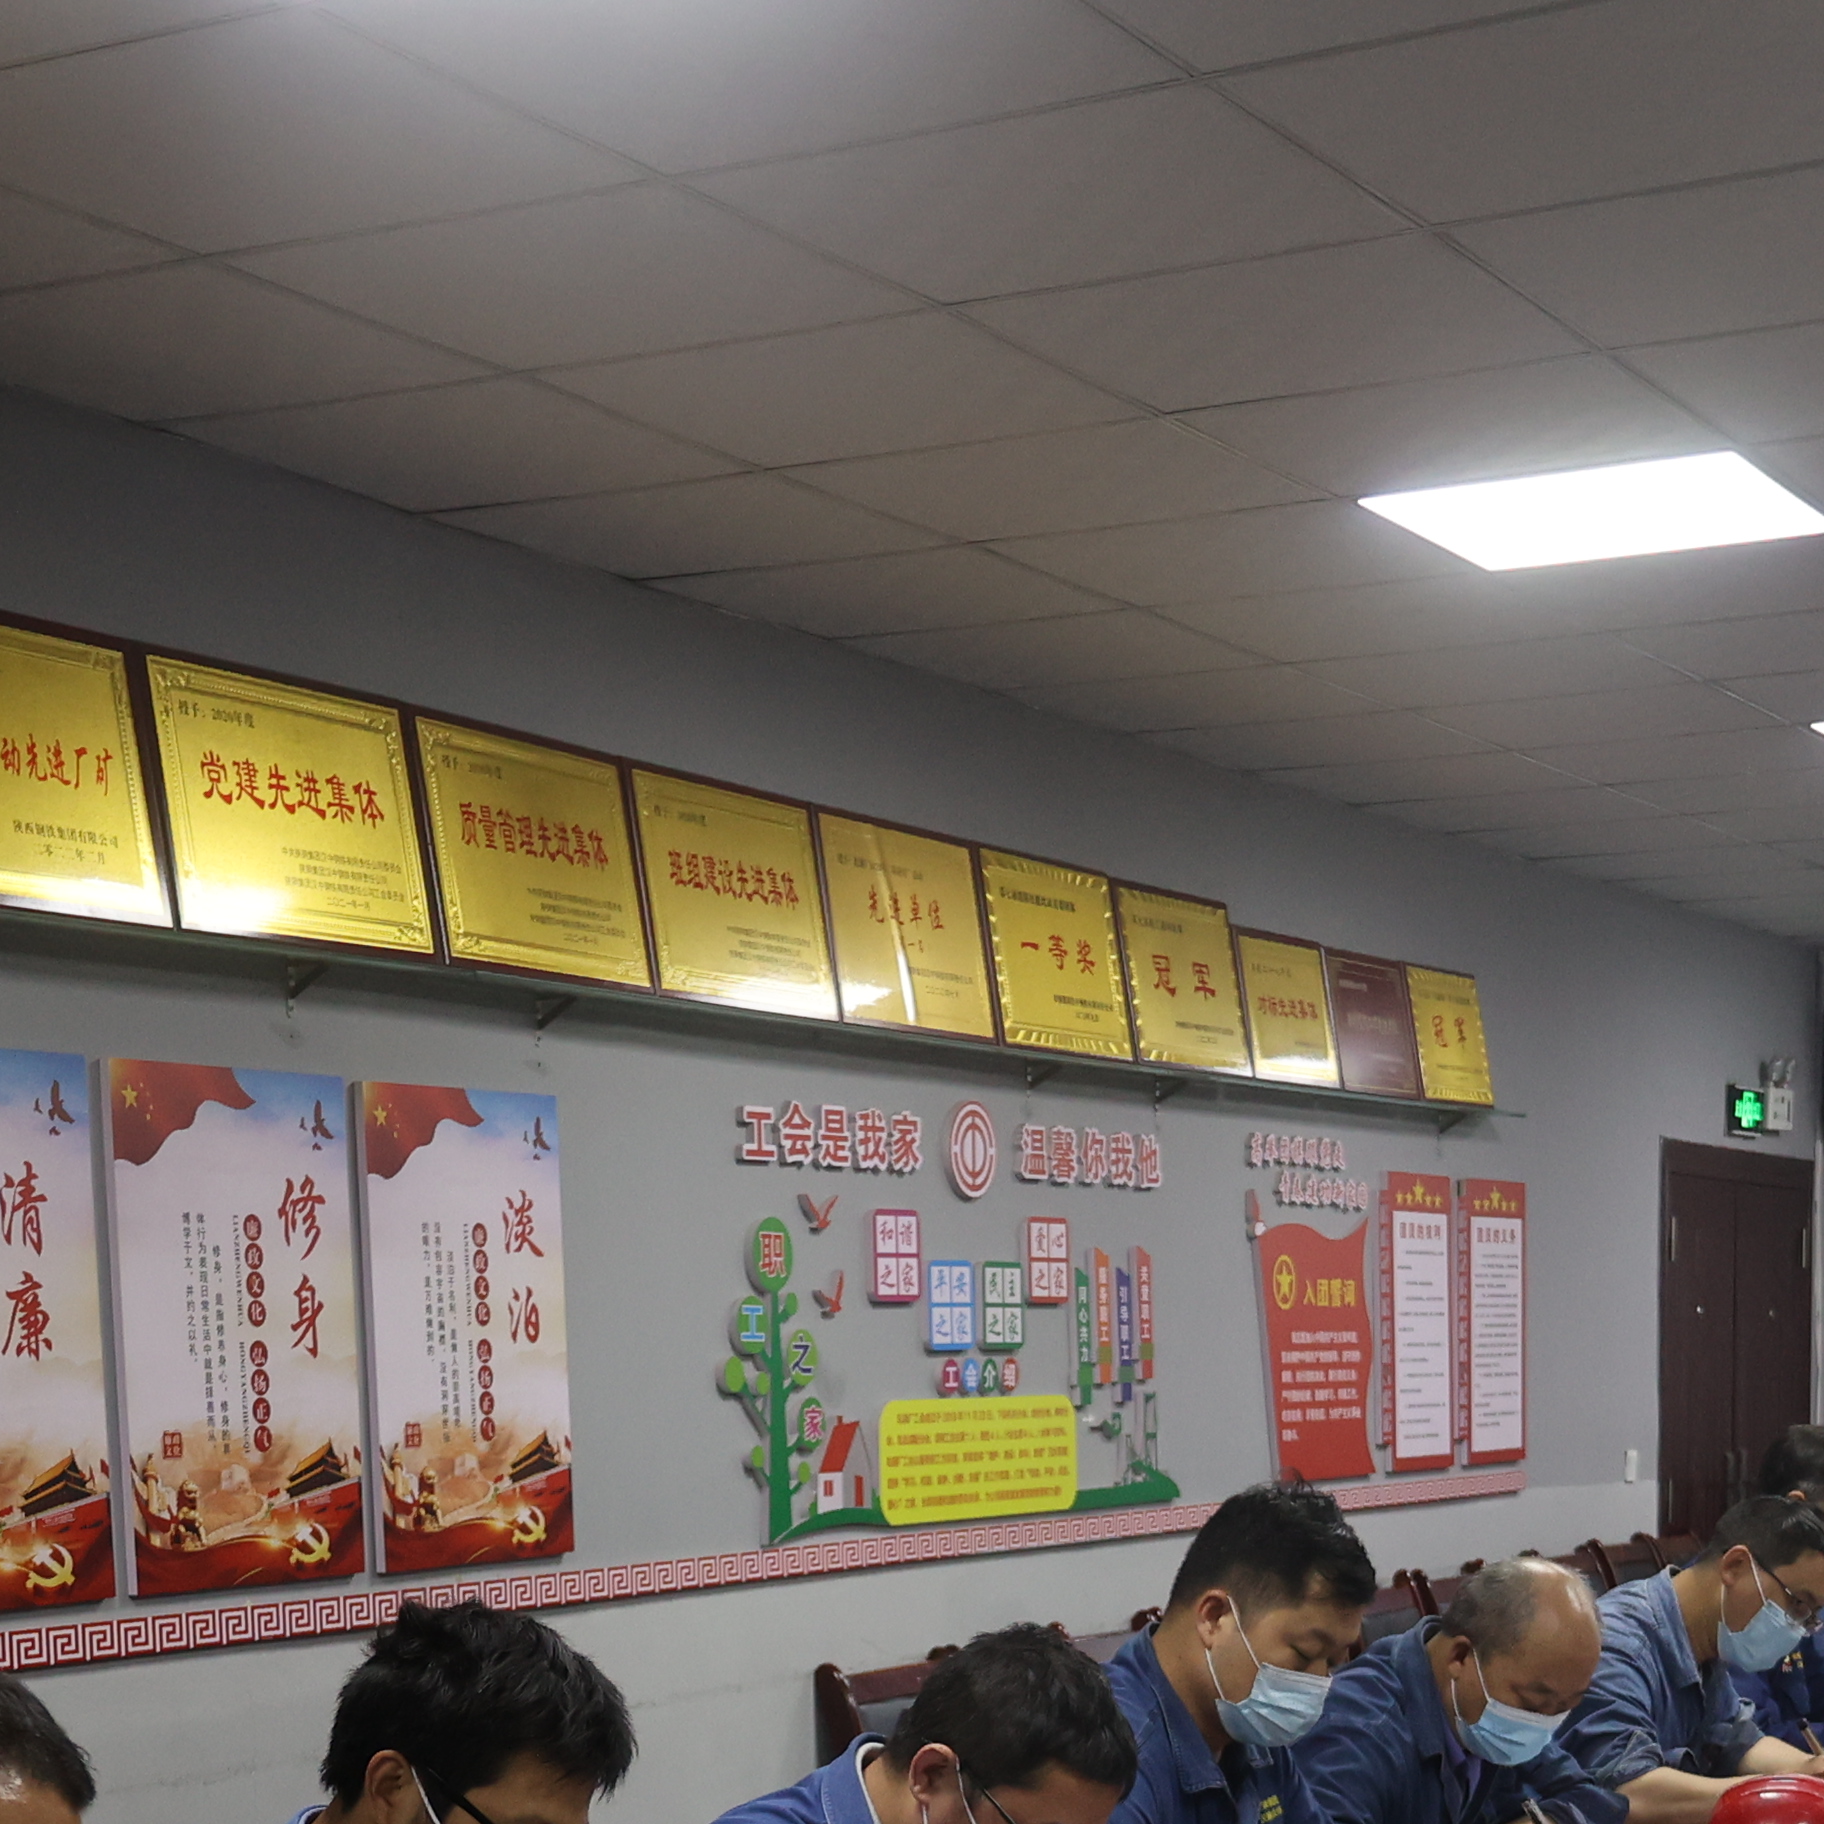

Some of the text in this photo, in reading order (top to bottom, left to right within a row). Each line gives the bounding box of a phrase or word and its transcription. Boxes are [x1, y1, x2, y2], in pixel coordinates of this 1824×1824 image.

[200, 750, 384, 829] 党建先进集体
[459, 801, 609, 872] 质量管理先进集体
[668, 850, 799, 910] 班组建设先进集体
[742, 1103, 921, 1169] 工会是我家
[1022, 1125, 1161, 1186] 温馨你我他
[278, 1174, 327, 1360] 修身
[503, 1189, 544, 1344] 淡泊
[879, 1262, 916, 1290] 之家
[1303, 1277, 1357, 1308] 入团誓词
[935, 1314, 968, 1342] 之家
[987, 1313, 1019, 1343] 之家
[944, 1363, 1017, 1387] 工会介绍
